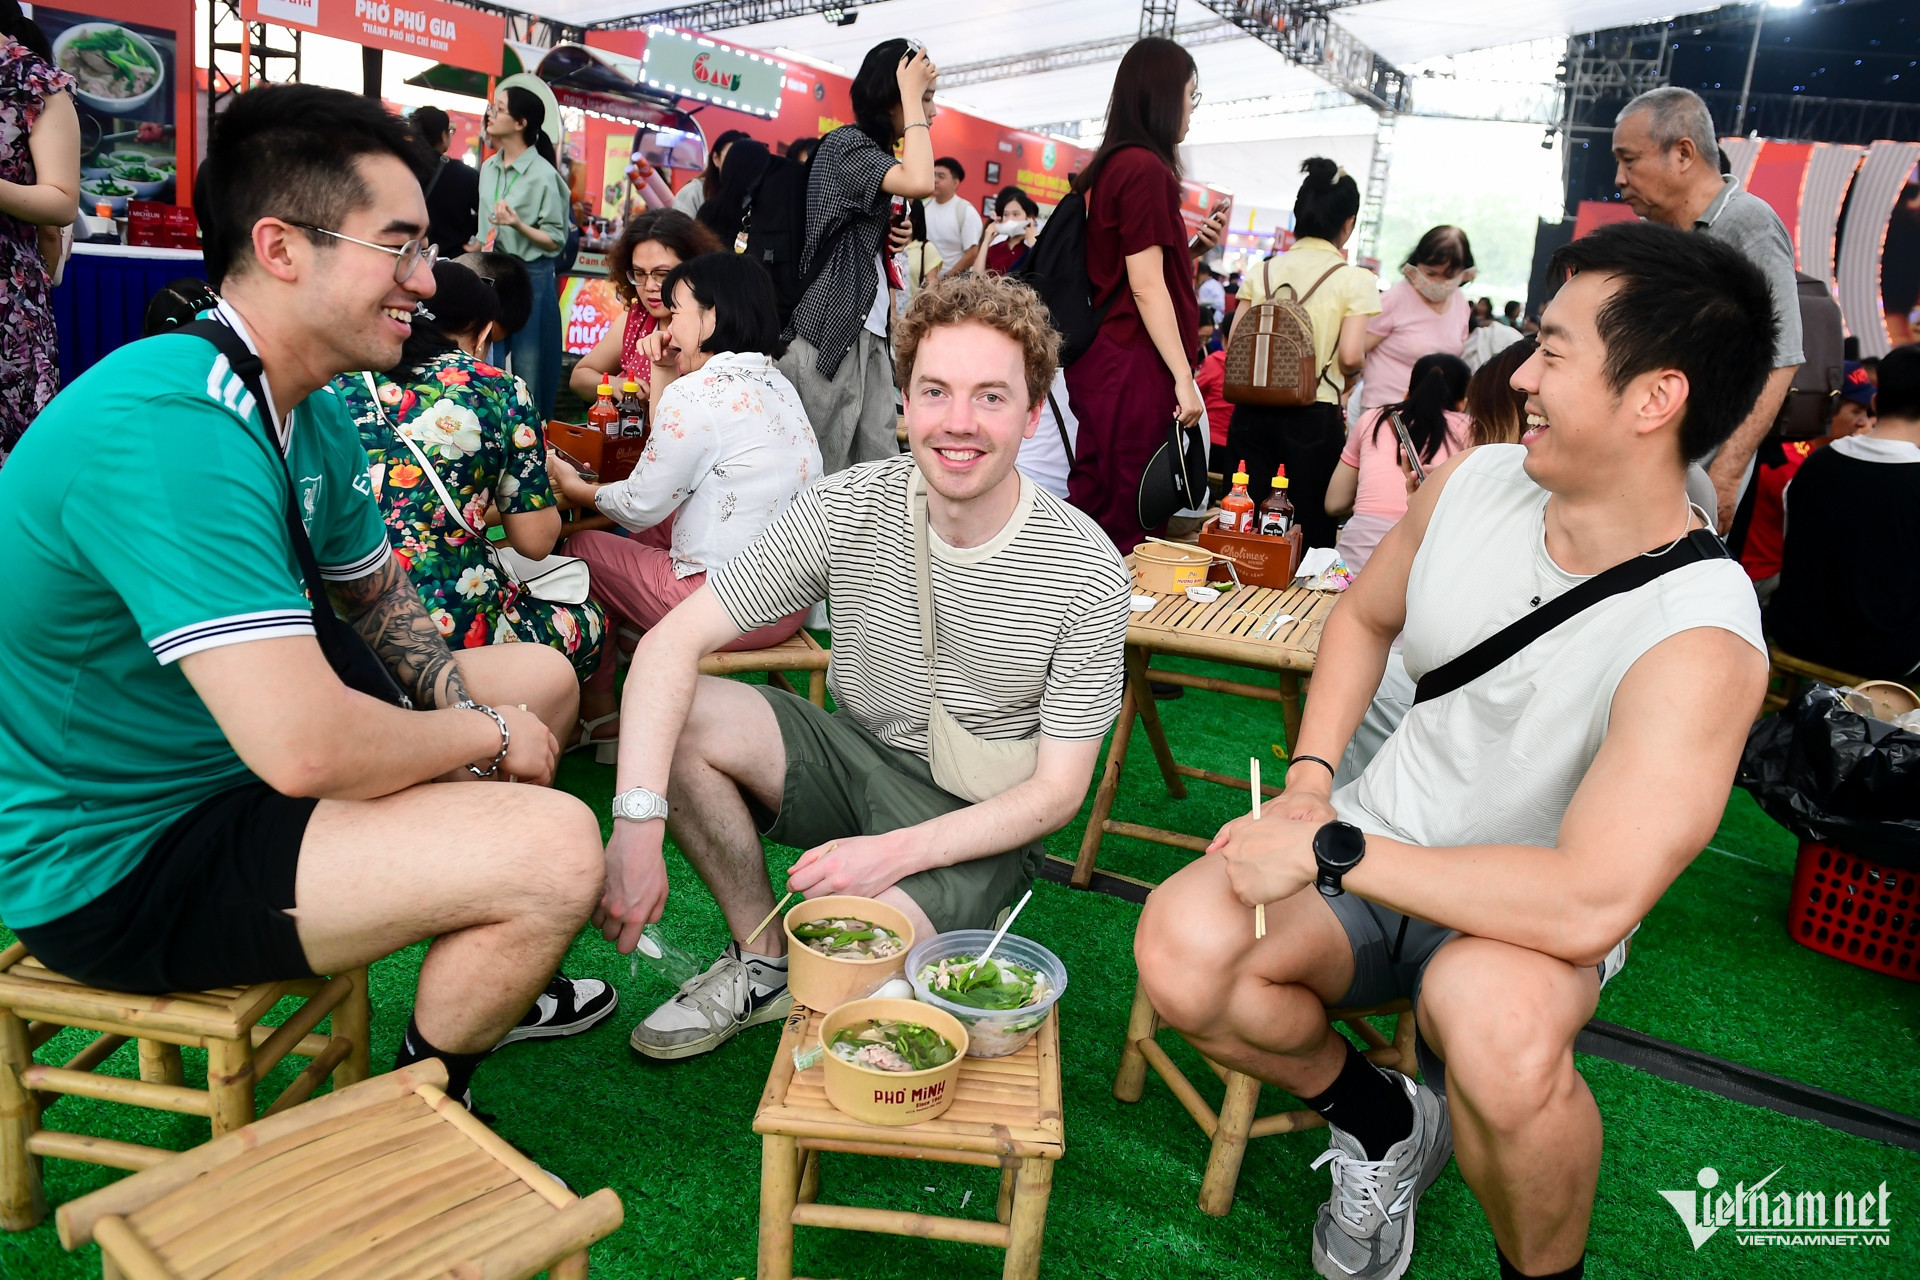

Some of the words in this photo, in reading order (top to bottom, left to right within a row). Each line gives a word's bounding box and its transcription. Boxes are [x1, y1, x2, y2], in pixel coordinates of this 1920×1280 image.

[429, 17, 456, 40] GIA
[430, 39, 449, 51] MINH
[578, 255, 598, 266] Cam
[571, 304, 596, 322] xe
[1220, 544, 1266, 562] Cholimex
